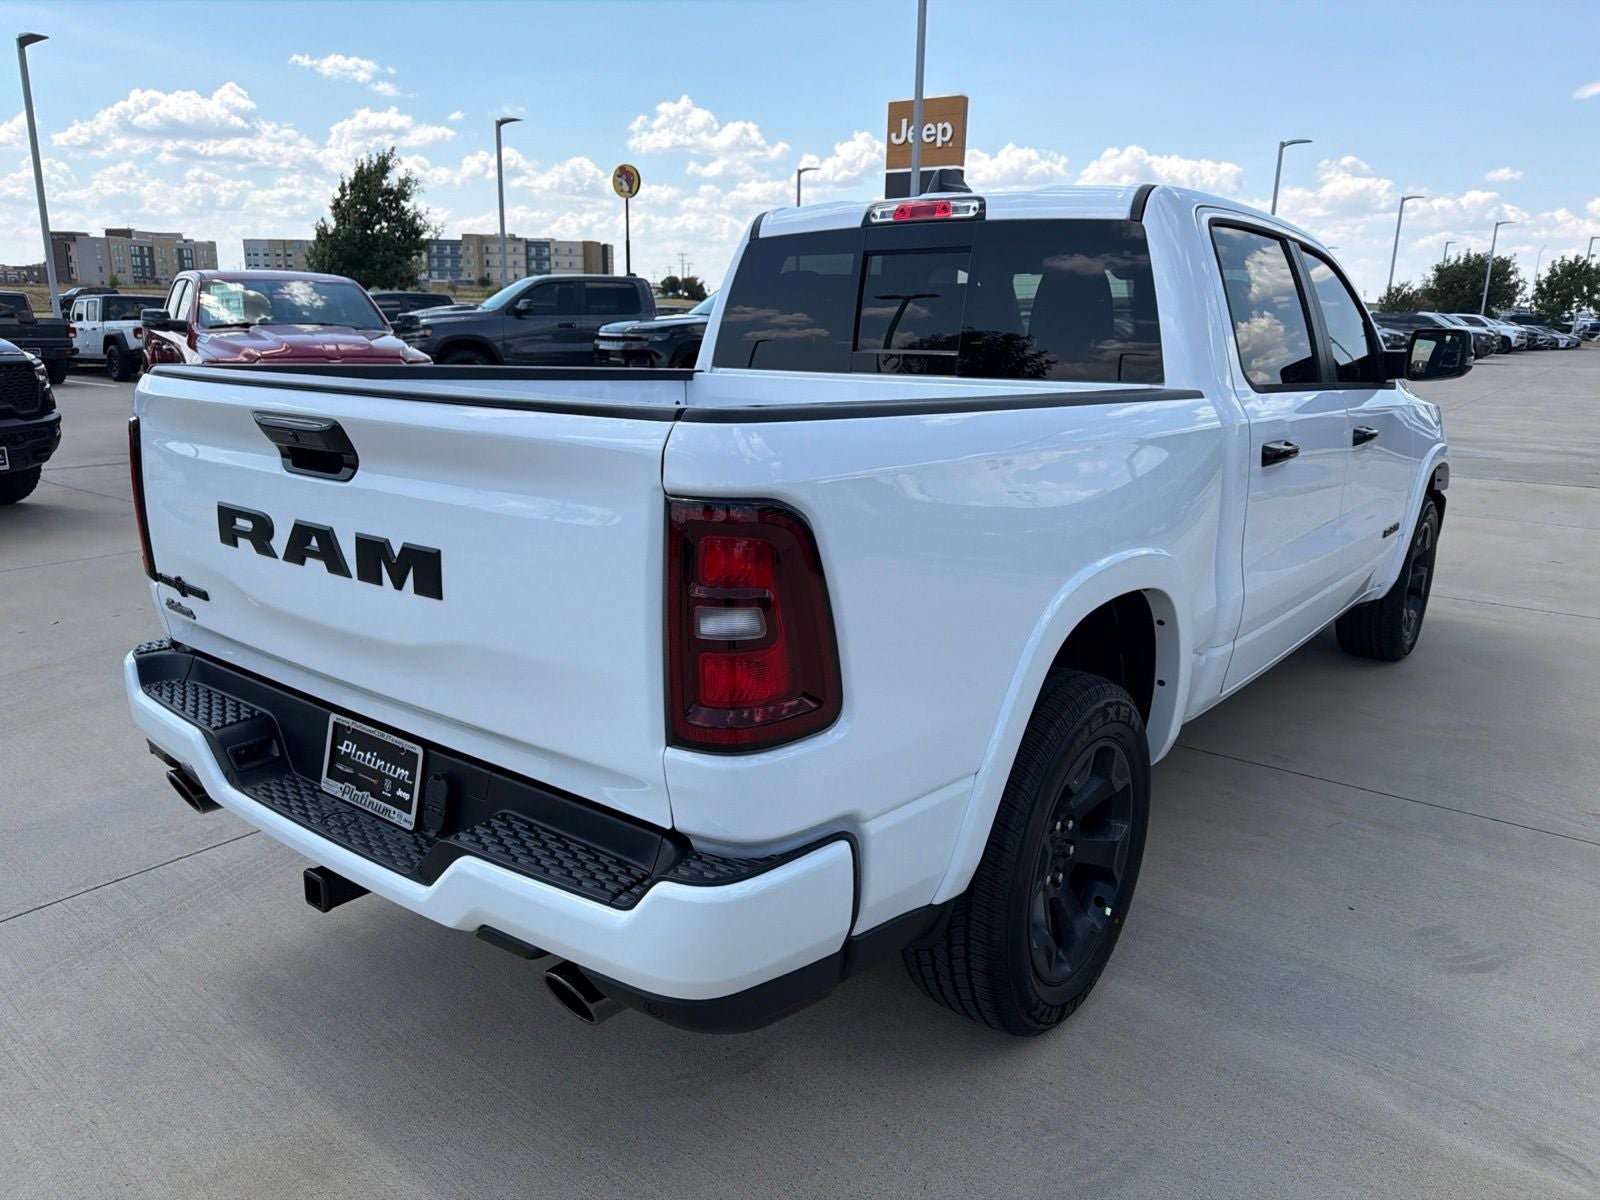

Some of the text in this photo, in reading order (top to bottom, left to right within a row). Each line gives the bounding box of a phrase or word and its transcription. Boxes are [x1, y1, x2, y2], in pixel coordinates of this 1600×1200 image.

[217, 501, 444, 601] RAM
[336, 740, 413, 785] Platinum
[341, 783, 396, 820] Platinum
[395, 787, 411, 802] Jeep
